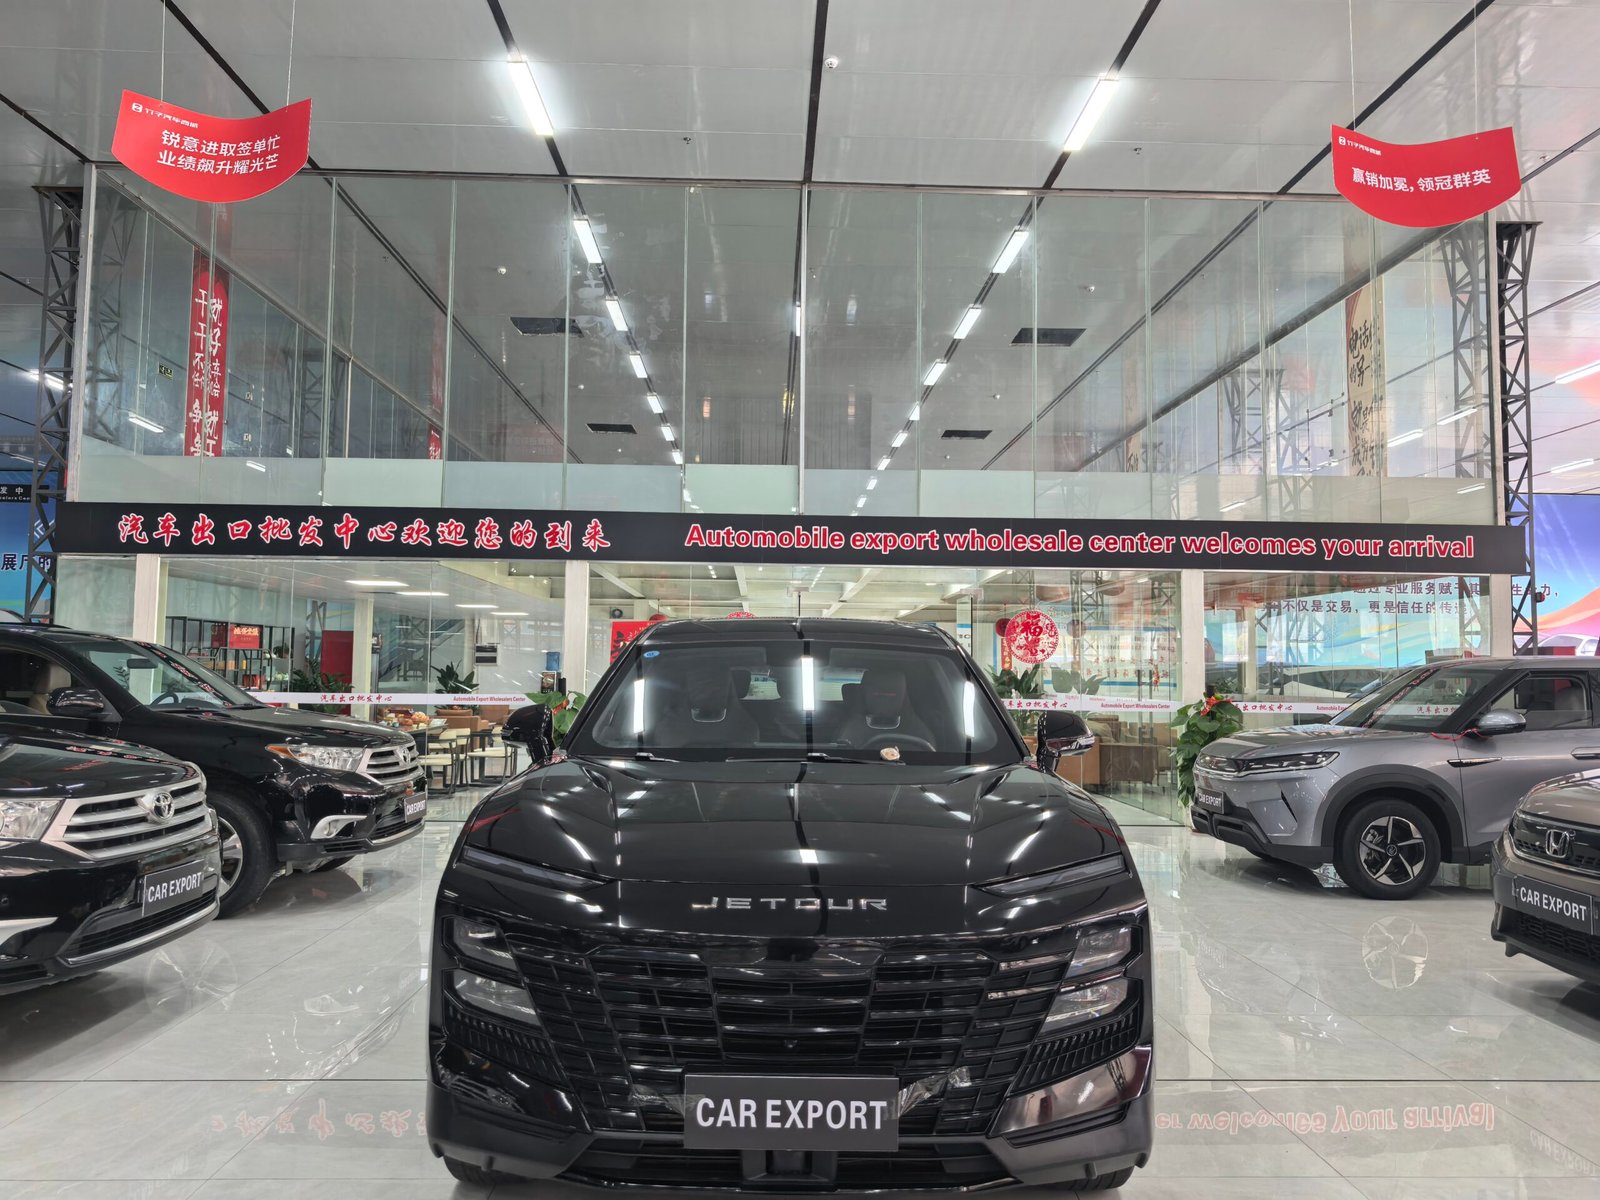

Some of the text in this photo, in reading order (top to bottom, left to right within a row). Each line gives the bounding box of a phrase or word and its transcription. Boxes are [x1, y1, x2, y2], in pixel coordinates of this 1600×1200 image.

[161, 129, 281, 157] 锐意进取签单忙
[157, 149, 279, 176] 业绩飙升耀光芒
[117, 512, 611, 550] 汽车出口批发中心欢迎您的到来
[684, 523, 1475, 560] Automobile export wholesale center welcomes your arrival
[1003, 700, 1068, 709] 车出口批发中心
[148, 871, 202, 903] CAR EXPORT
[691, 896, 888, 911] JETOUR
[1520, 886, 1587, 922] CAR EXPORT
[696, 1097, 888, 1130] CAR EXPORT
